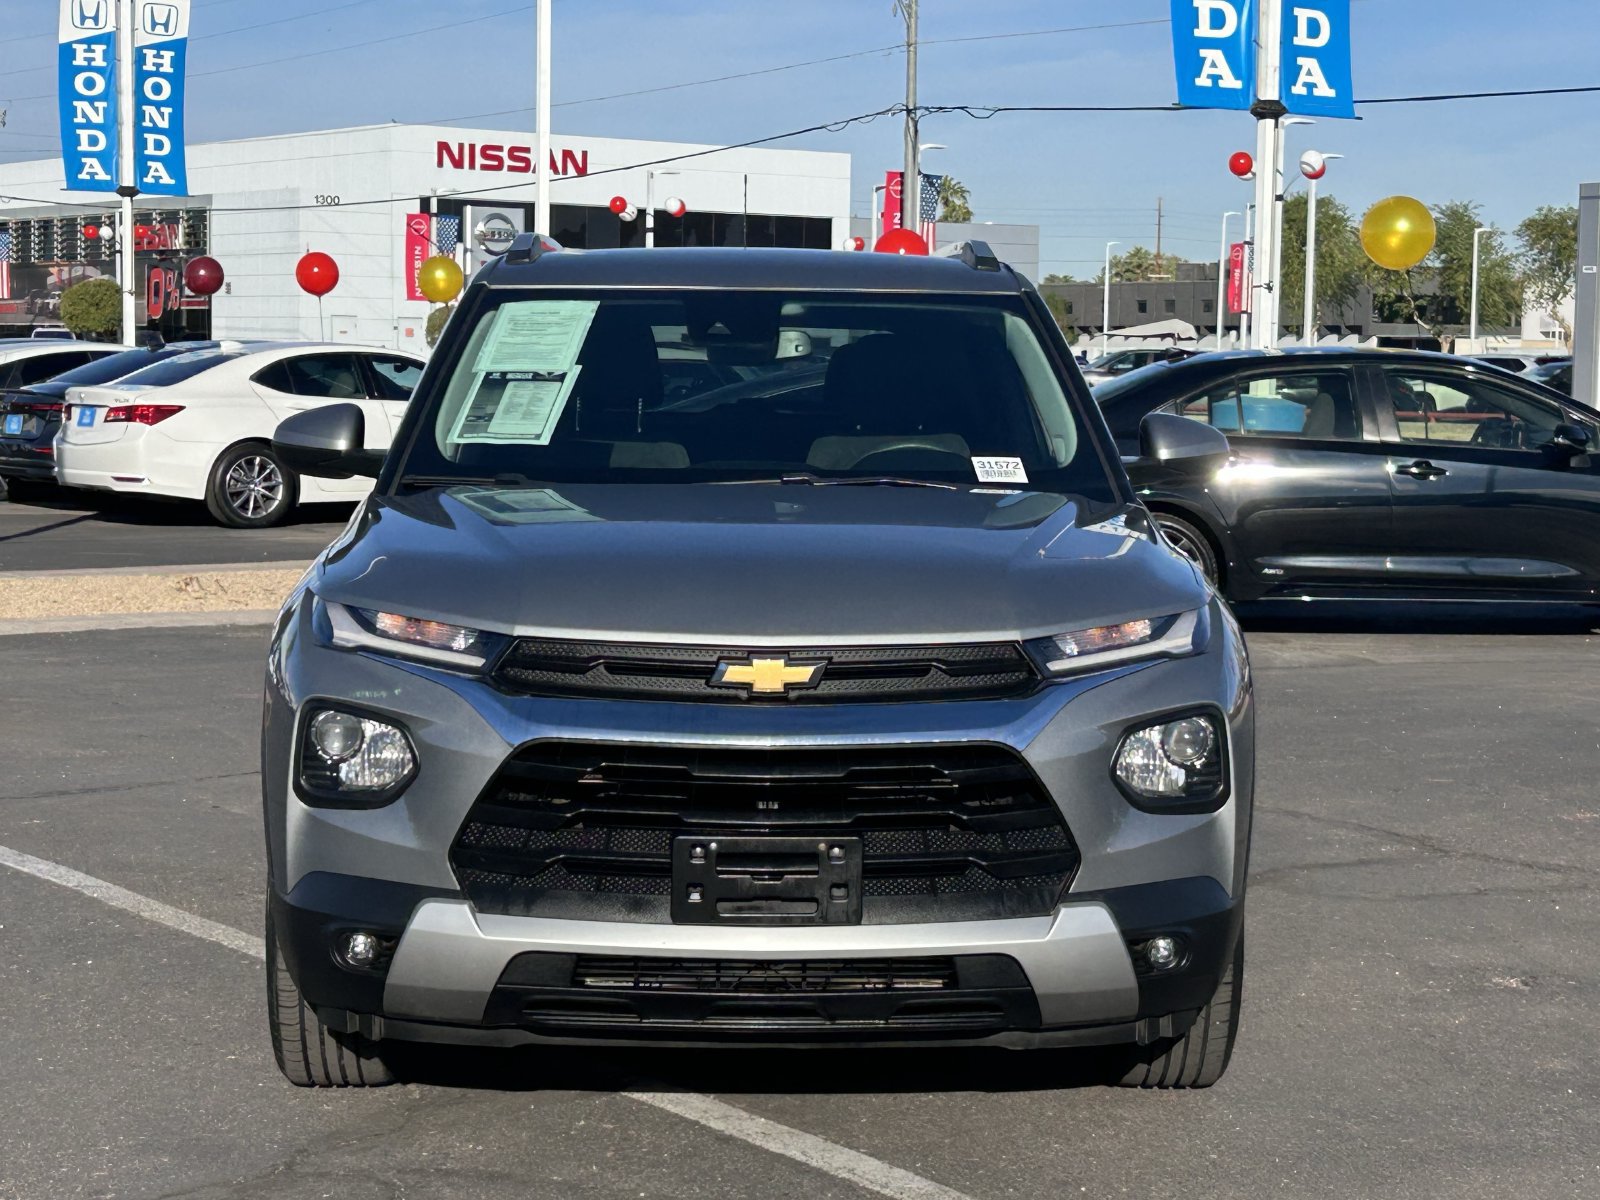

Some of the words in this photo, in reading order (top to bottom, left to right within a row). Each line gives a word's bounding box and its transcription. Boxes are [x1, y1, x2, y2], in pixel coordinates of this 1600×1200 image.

[1291, 7, 1336, 97] DA
[72, 43, 111, 181] HONDA
[142, 49, 175, 185] HONDA
[314, 195, 340, 206] 1300
